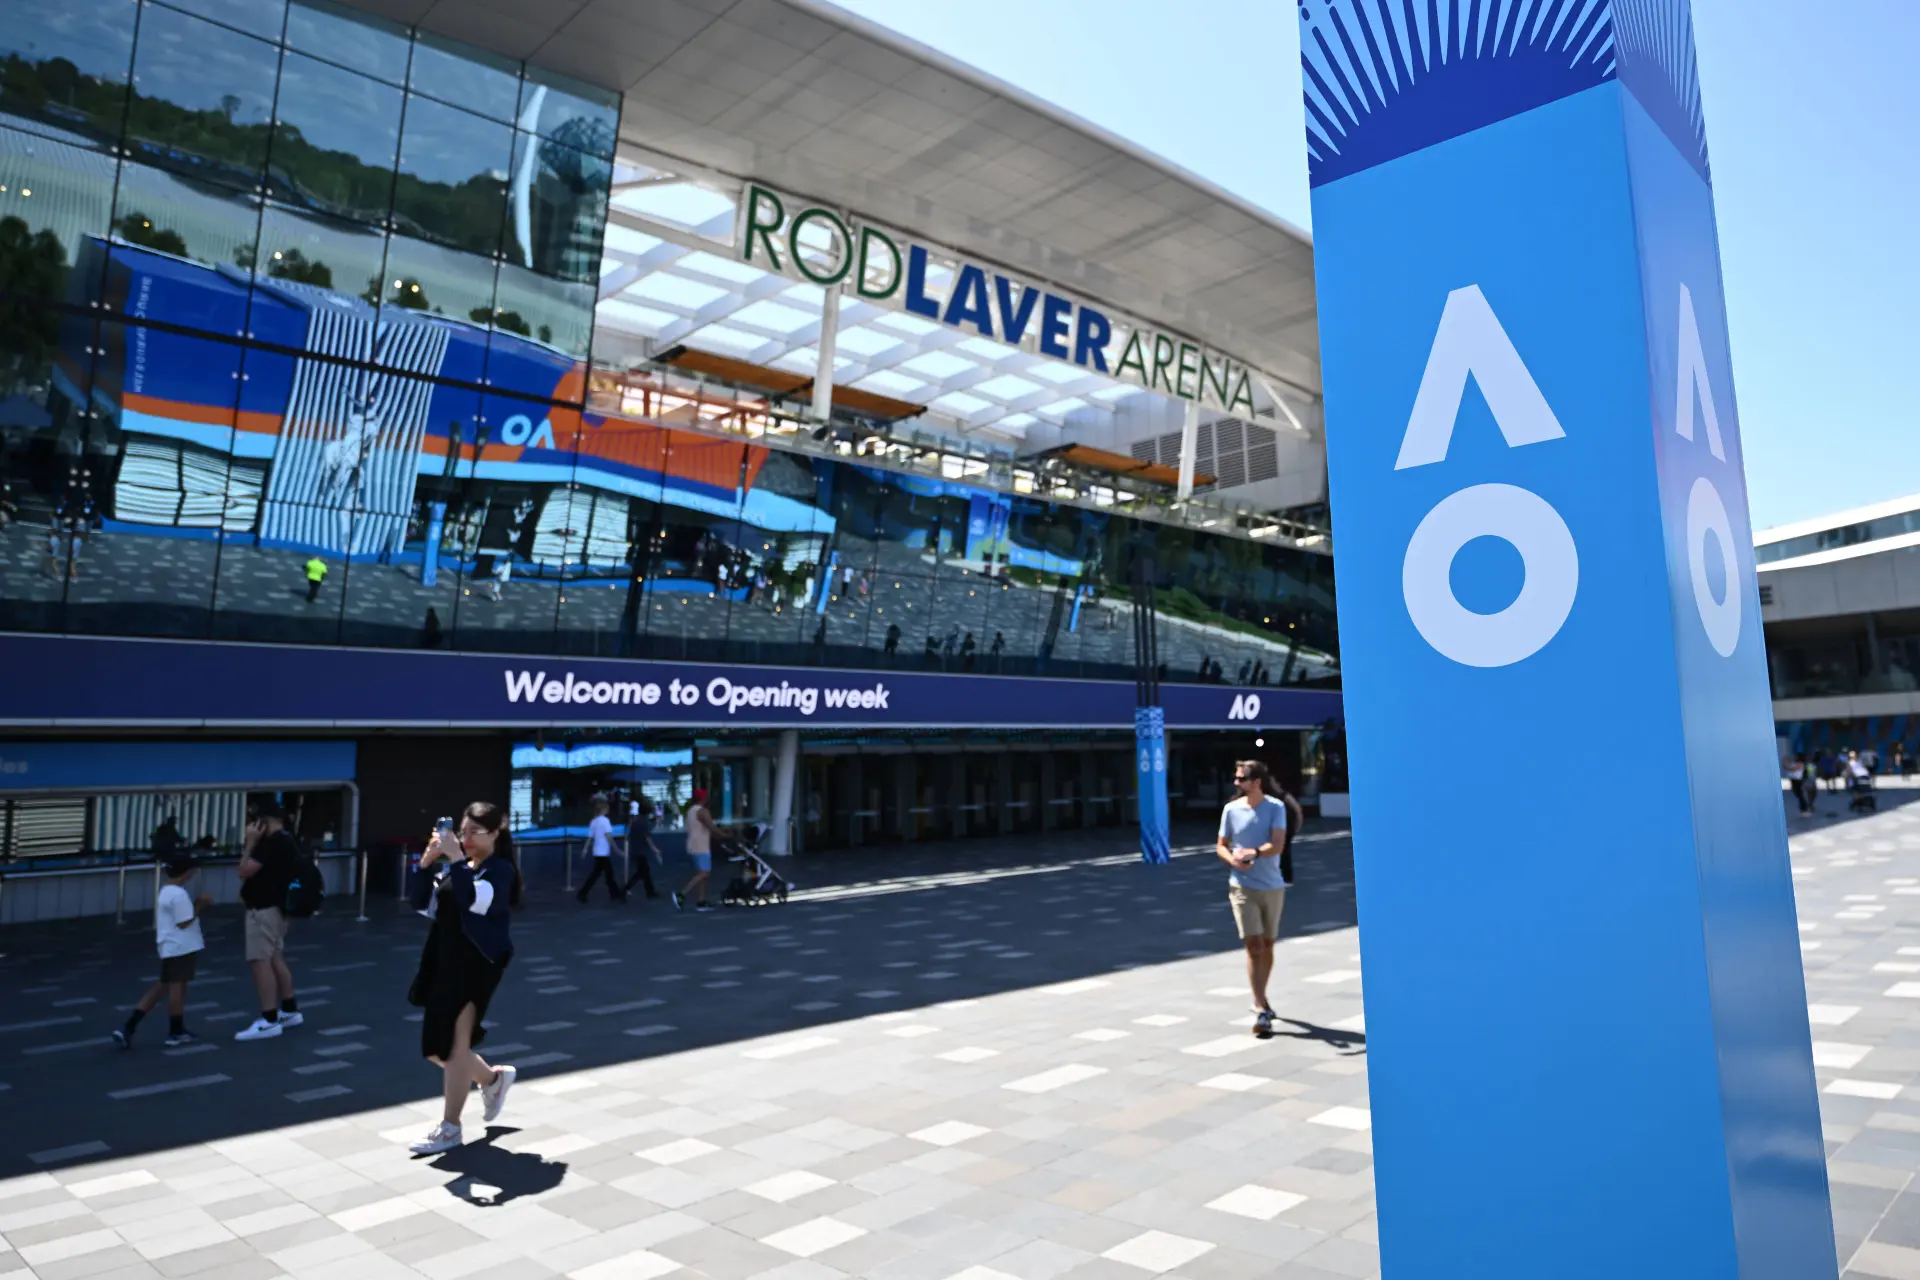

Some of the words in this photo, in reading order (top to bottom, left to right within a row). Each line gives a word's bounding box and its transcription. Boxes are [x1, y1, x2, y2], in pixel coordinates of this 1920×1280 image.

[744, 184, 903, 300] ROD
[905, 243, 1112, 375] LAVER
[1114, 328, 1256, 421] ARENA
[504, 669, 662, 704] Welcome
[668, 678, 700, 706] to
[705, 676, 819, 715] Opening
[823, 683, 891, 710] week
[1228, 693, 1261, 720] AO
